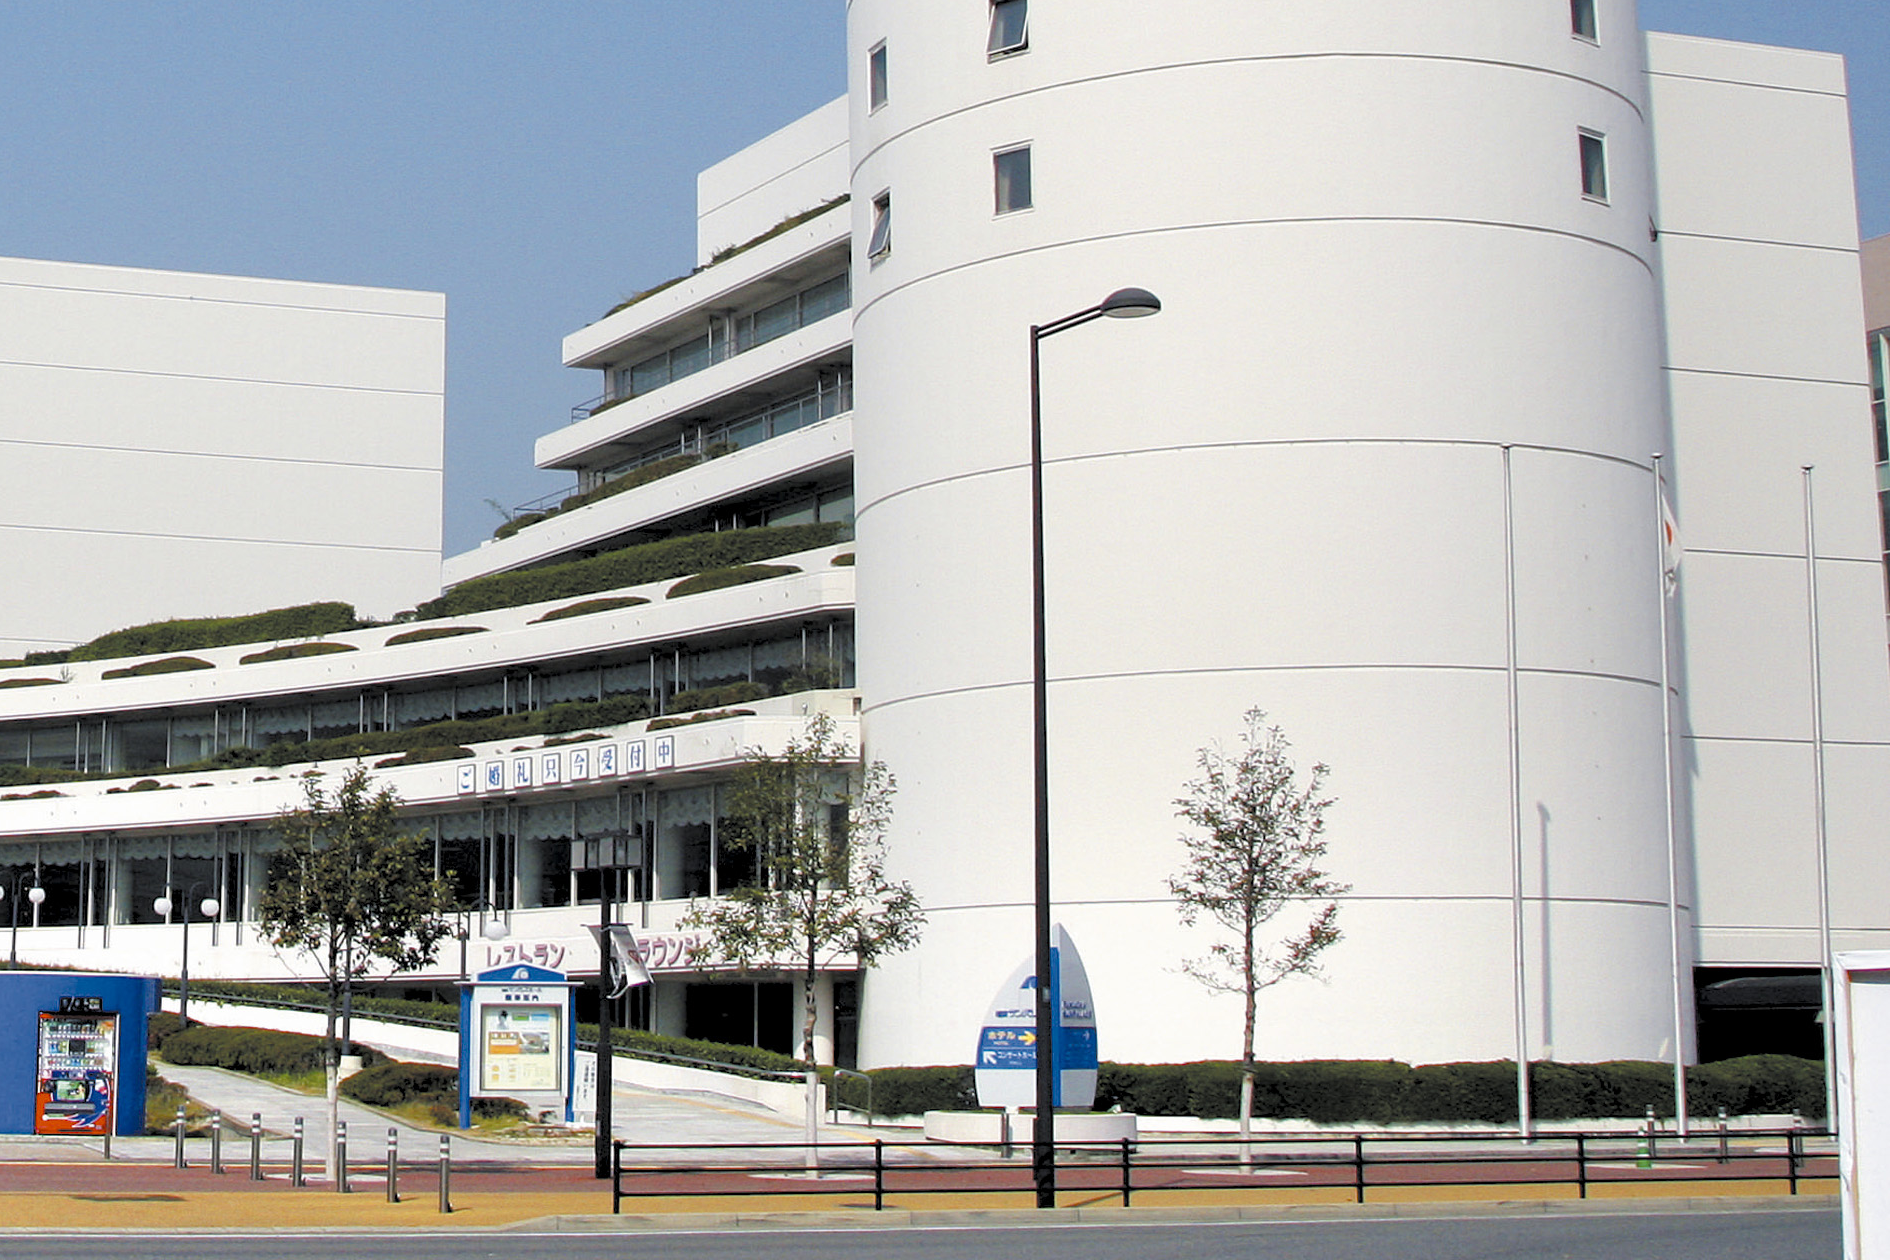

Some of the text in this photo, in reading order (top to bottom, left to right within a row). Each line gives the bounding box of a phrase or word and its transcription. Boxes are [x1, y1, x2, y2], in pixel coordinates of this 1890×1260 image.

[460, 741, 671, 789] ご婚礼只今受付中
[487, 942, 566, 968] レストラン
